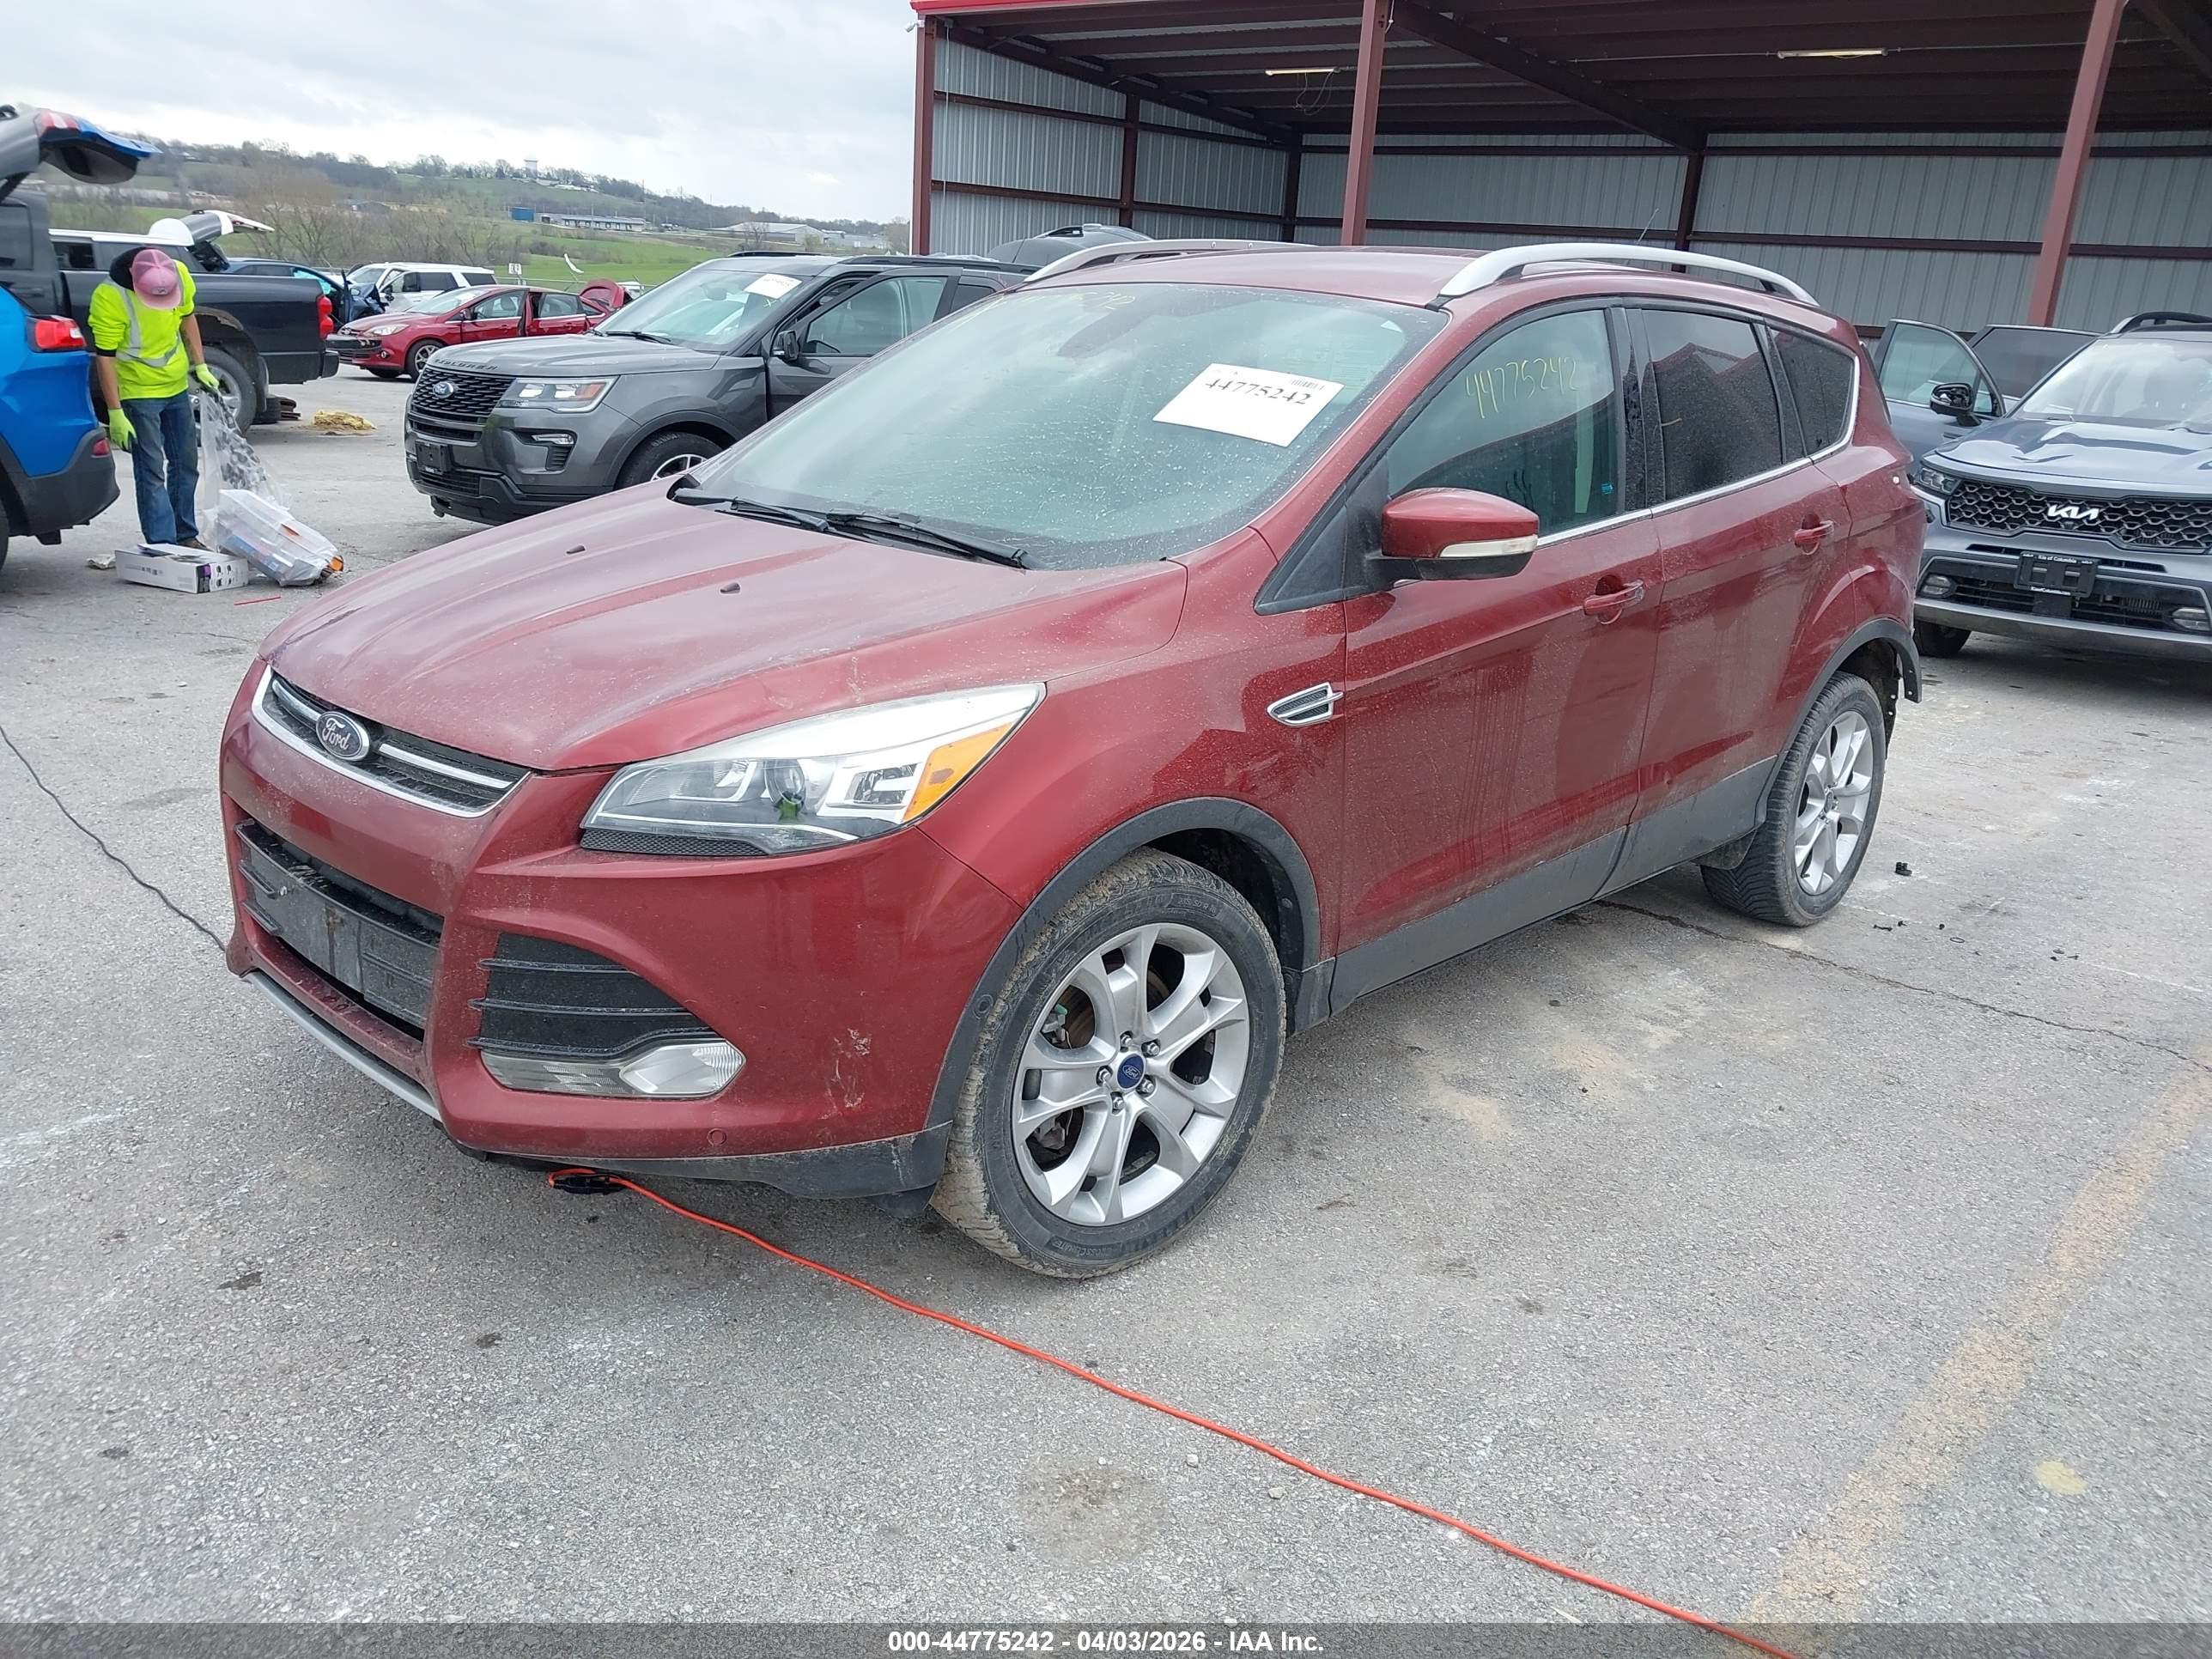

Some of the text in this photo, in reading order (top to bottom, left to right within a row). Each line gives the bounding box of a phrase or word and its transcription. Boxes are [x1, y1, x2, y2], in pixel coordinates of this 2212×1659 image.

[1205, 378, 1312, 404] 44775242
[1465, 356, 1582, 419] 44775242
[2047, 504, 2100, 520] KIA
[322, 718, 351, 750] Ford
